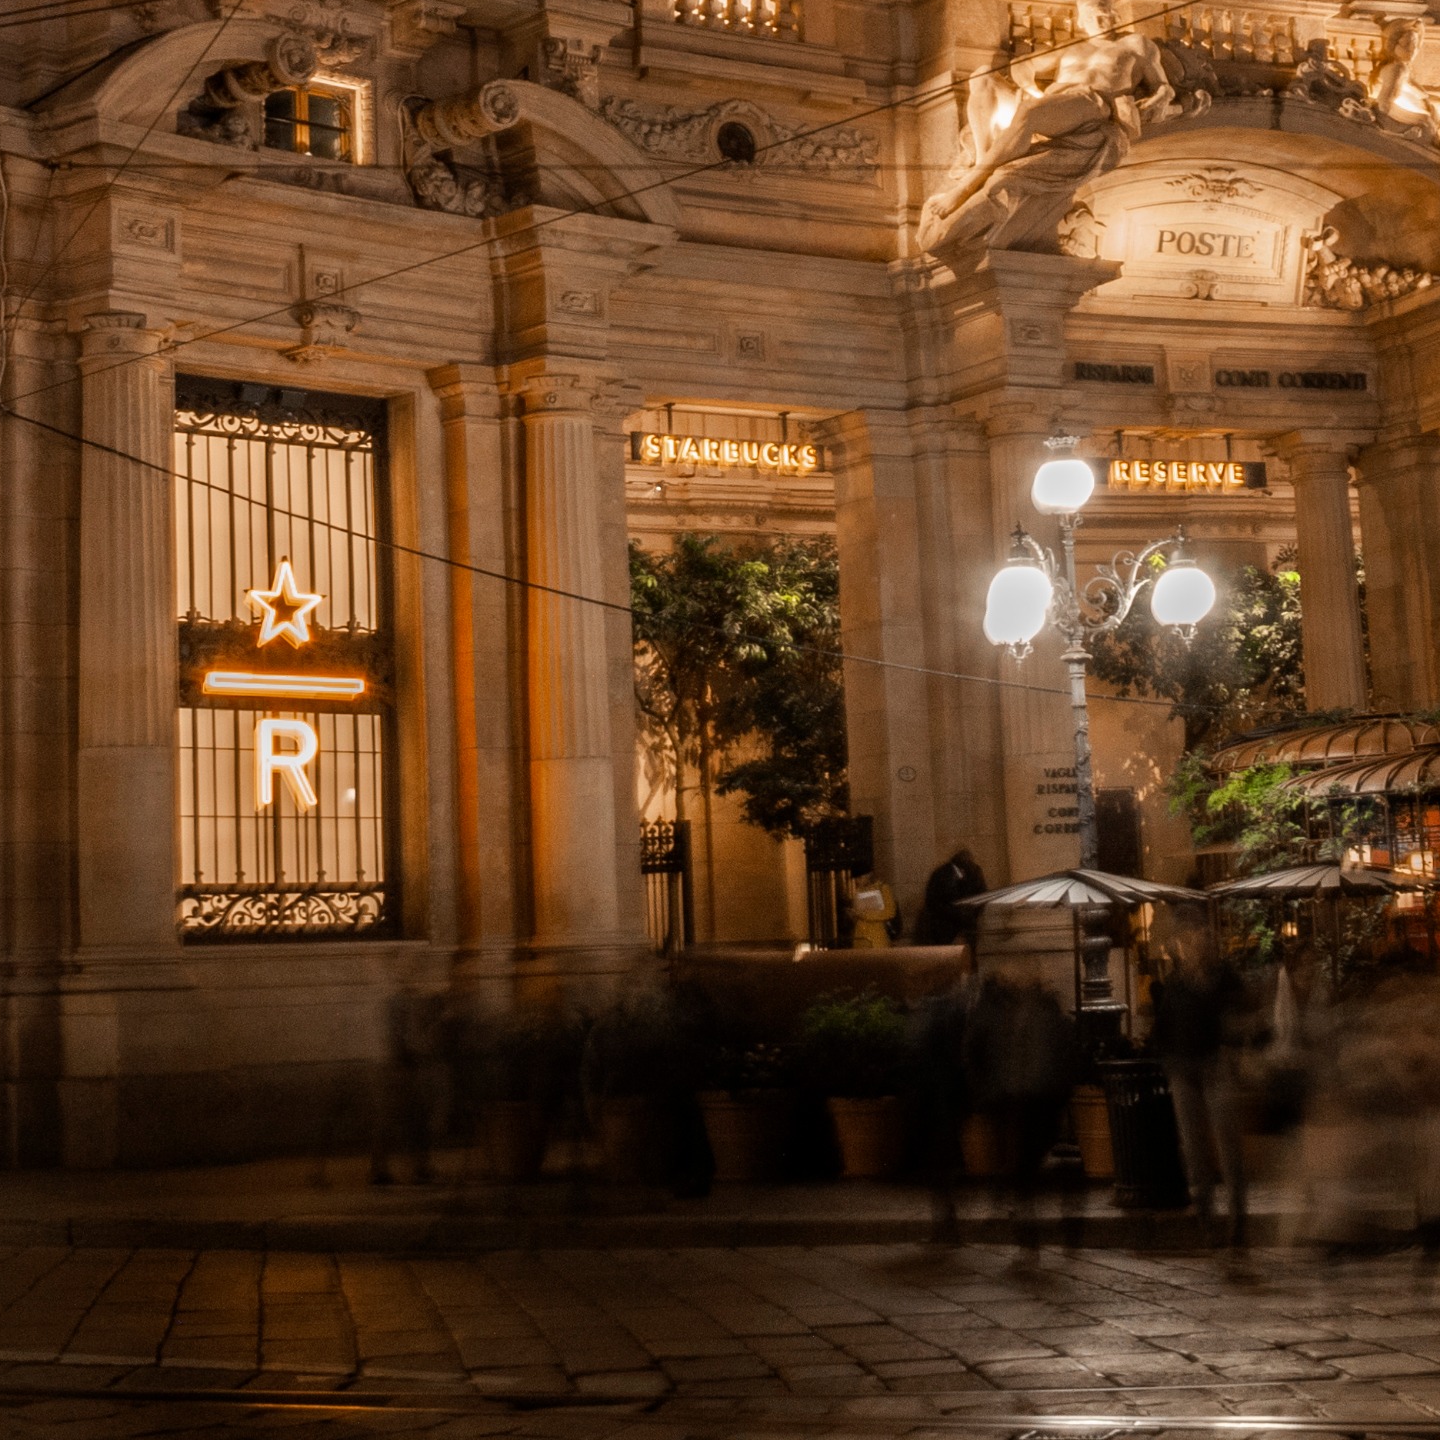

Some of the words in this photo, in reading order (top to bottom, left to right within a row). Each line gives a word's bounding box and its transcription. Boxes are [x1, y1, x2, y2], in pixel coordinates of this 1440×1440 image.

[1156, 230, 1255, 258] POSTE
[1215, 369, 1270, 388] CONTI
[643, 434, 817, 471] STARBUCKS
[1111, 460, 1244, 486] RESERVE
[257, 719, 318, 809] R
